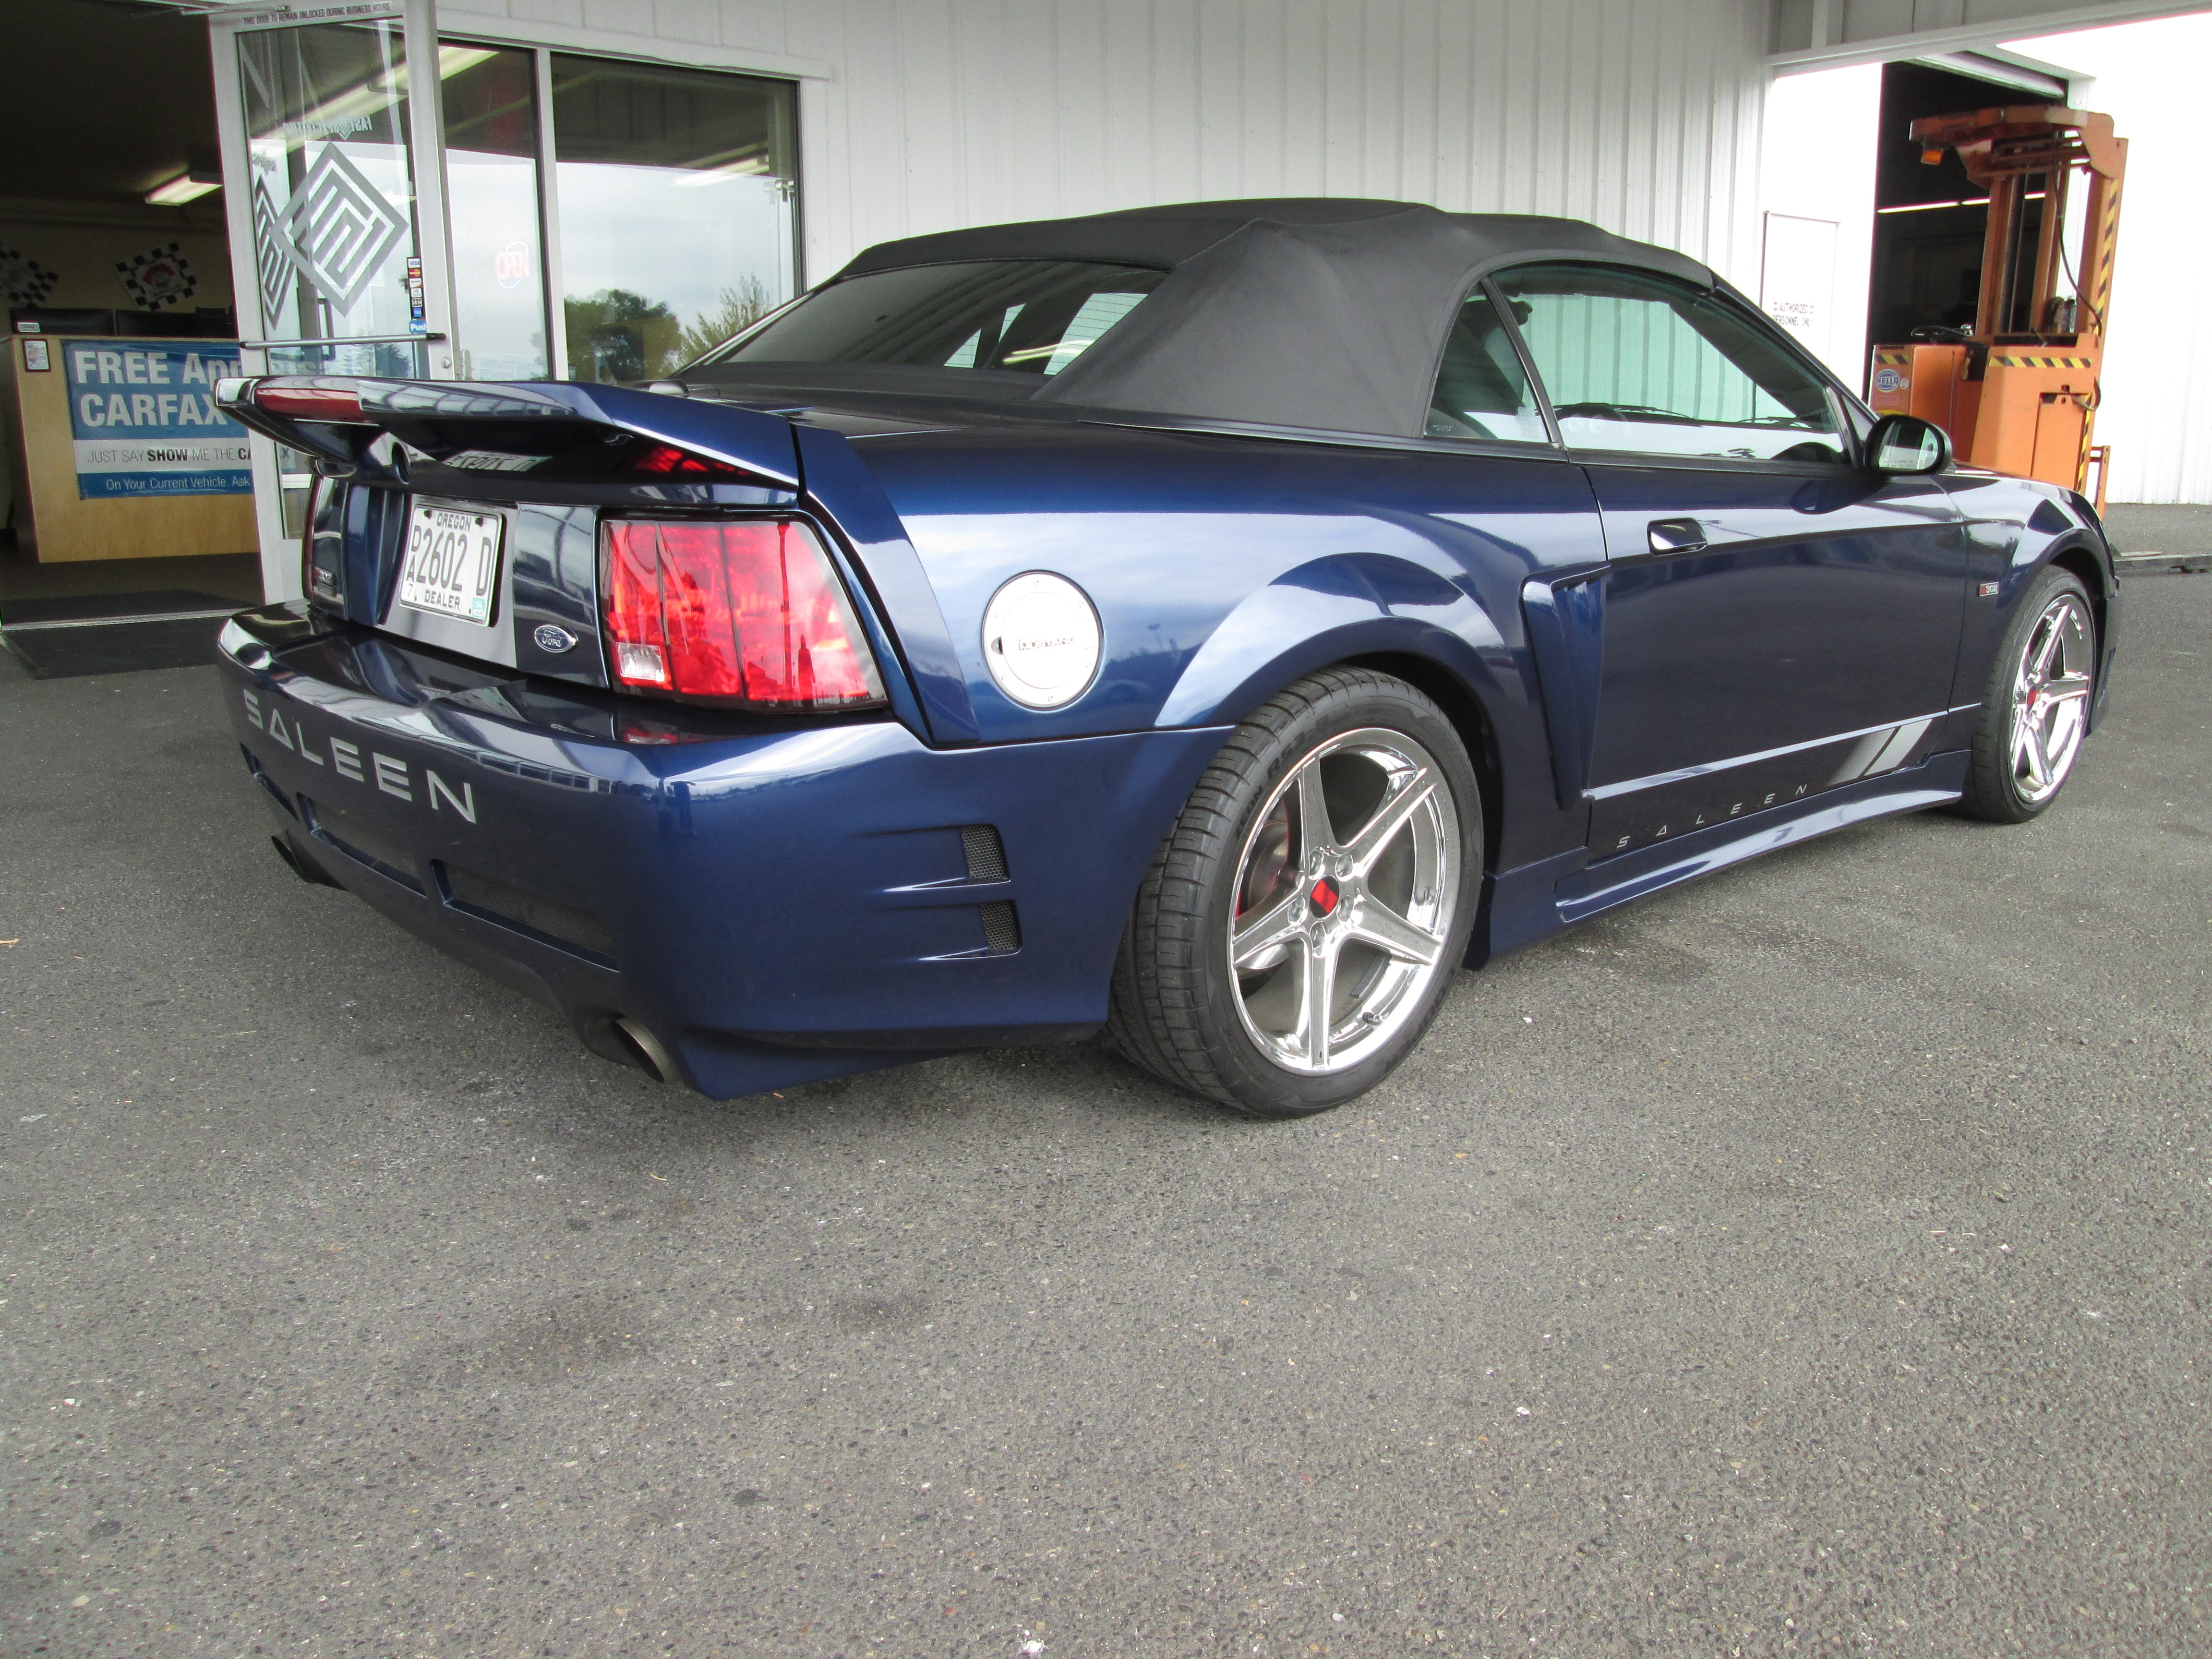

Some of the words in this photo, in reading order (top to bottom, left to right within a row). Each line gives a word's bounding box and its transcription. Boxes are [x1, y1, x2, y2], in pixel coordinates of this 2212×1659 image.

[299, 9, 325, 20] UNLOCKED
[326, 7, 345, 17] DURING
[346, 4, 372, 15] BUSINESS
[373, 2, 391, 12] HOURS
[1779, 302, 1808, 313] AUTHORIZED
[74, 350, 170, 385] FREE
[1877, 376, 1899, 385] HELLA
[80, 393, 228, 427] CARFAX
[88, 450, 119, 463] JUST
[121, 450, 144, 462] SAY
[147, 448, 188, 462] SHOW
[192, 447, 210, 461] ME
[213, 447, 235, 460] THE
[106, 479, 121, 491] On
[123, 478, 146, 490] Your
[149, 477, 188, 490] Current
[191, 476, 229, 488] Vehicle.
[232, 475, 251, 487] Ask
[437, 512, 472, 531] OREGON
[416, 528, 468, 591] 2602
[407, 583, 413, 597] 7
[1985, 584, 1998, 594] 302
[424, 589, 461, 611] DEALER
[541, 629, 563, 648] Ford
[243, 688, 477, 824] SALEEN
[1616, 784, 1808, 849] SALEEN
